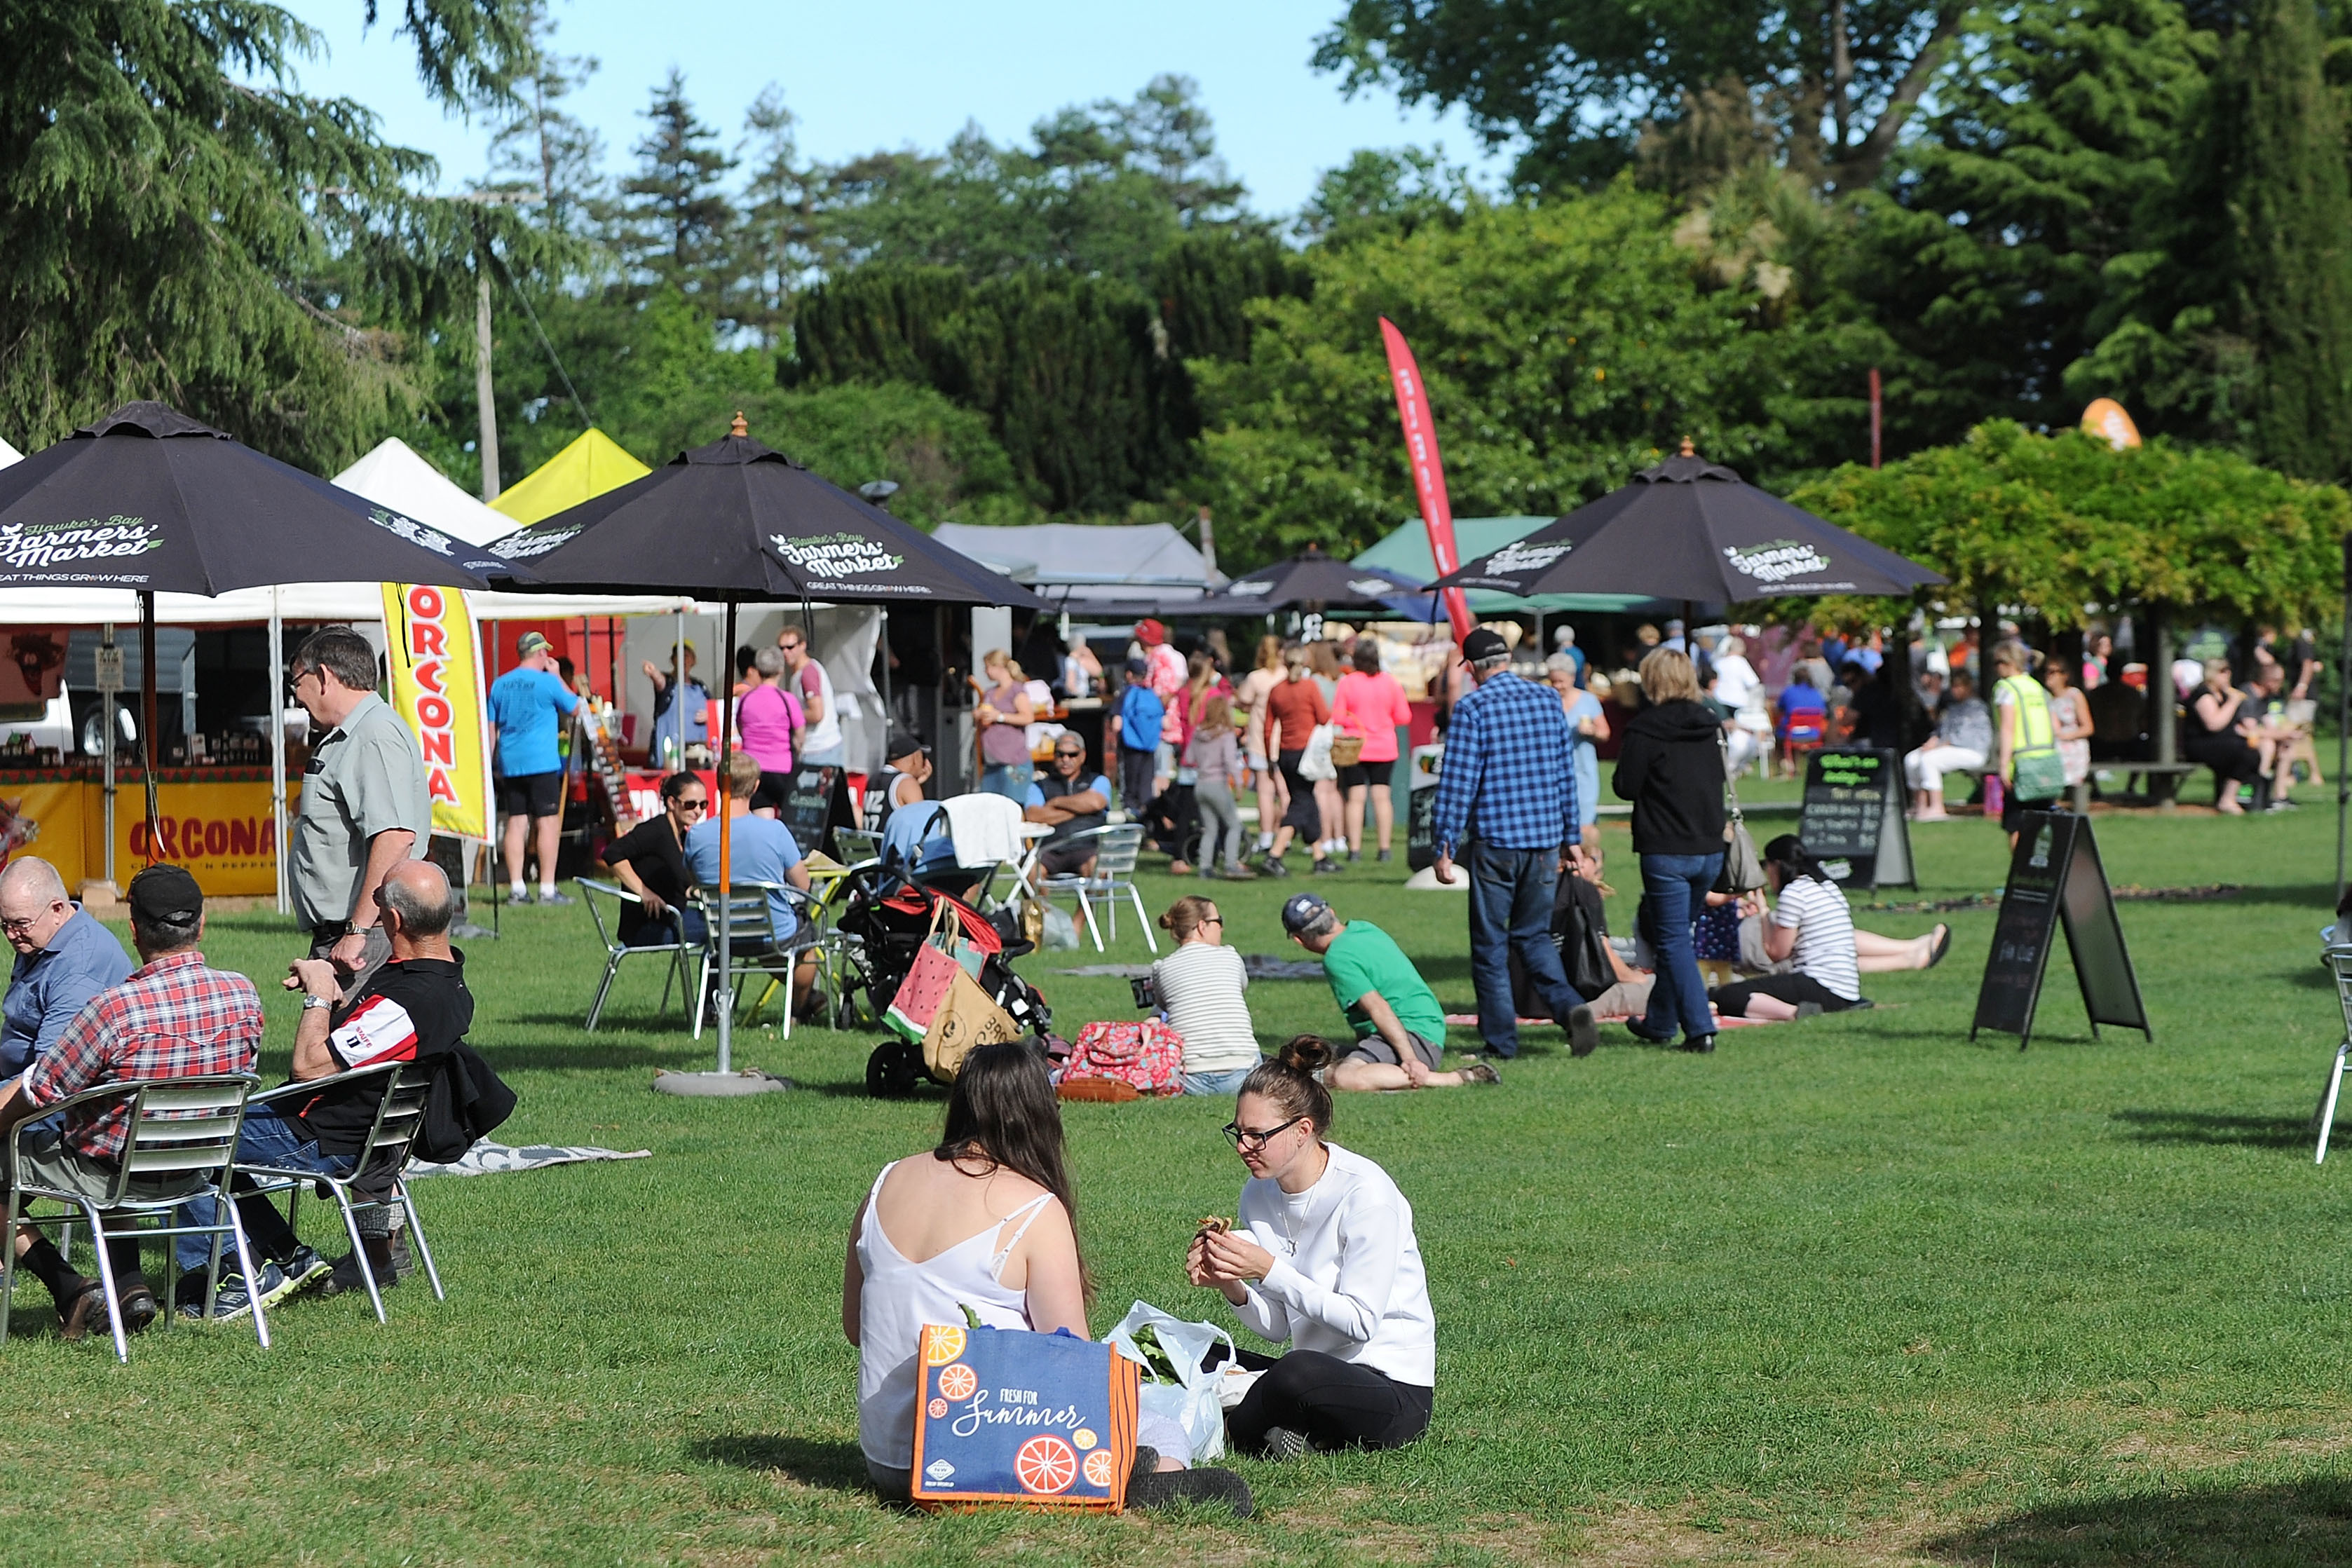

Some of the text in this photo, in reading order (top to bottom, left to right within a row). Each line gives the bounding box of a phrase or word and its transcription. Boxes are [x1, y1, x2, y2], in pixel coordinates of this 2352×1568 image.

[25, 514, 144, 536] Hawke's Bay
[6, 538, 149, 568] Market
[805, 553, 898, 579] Market
[22, 573, 69, 582] THINGS
[114, 574, 149, 583] HERE
[409, 585, 456, 804] ORCONA
[130, 815, 276, 859] ORCONA
[1000, 1389, 1038, 1405] FRESH FOR
[951, 1389, 1086, 1437] Summer
